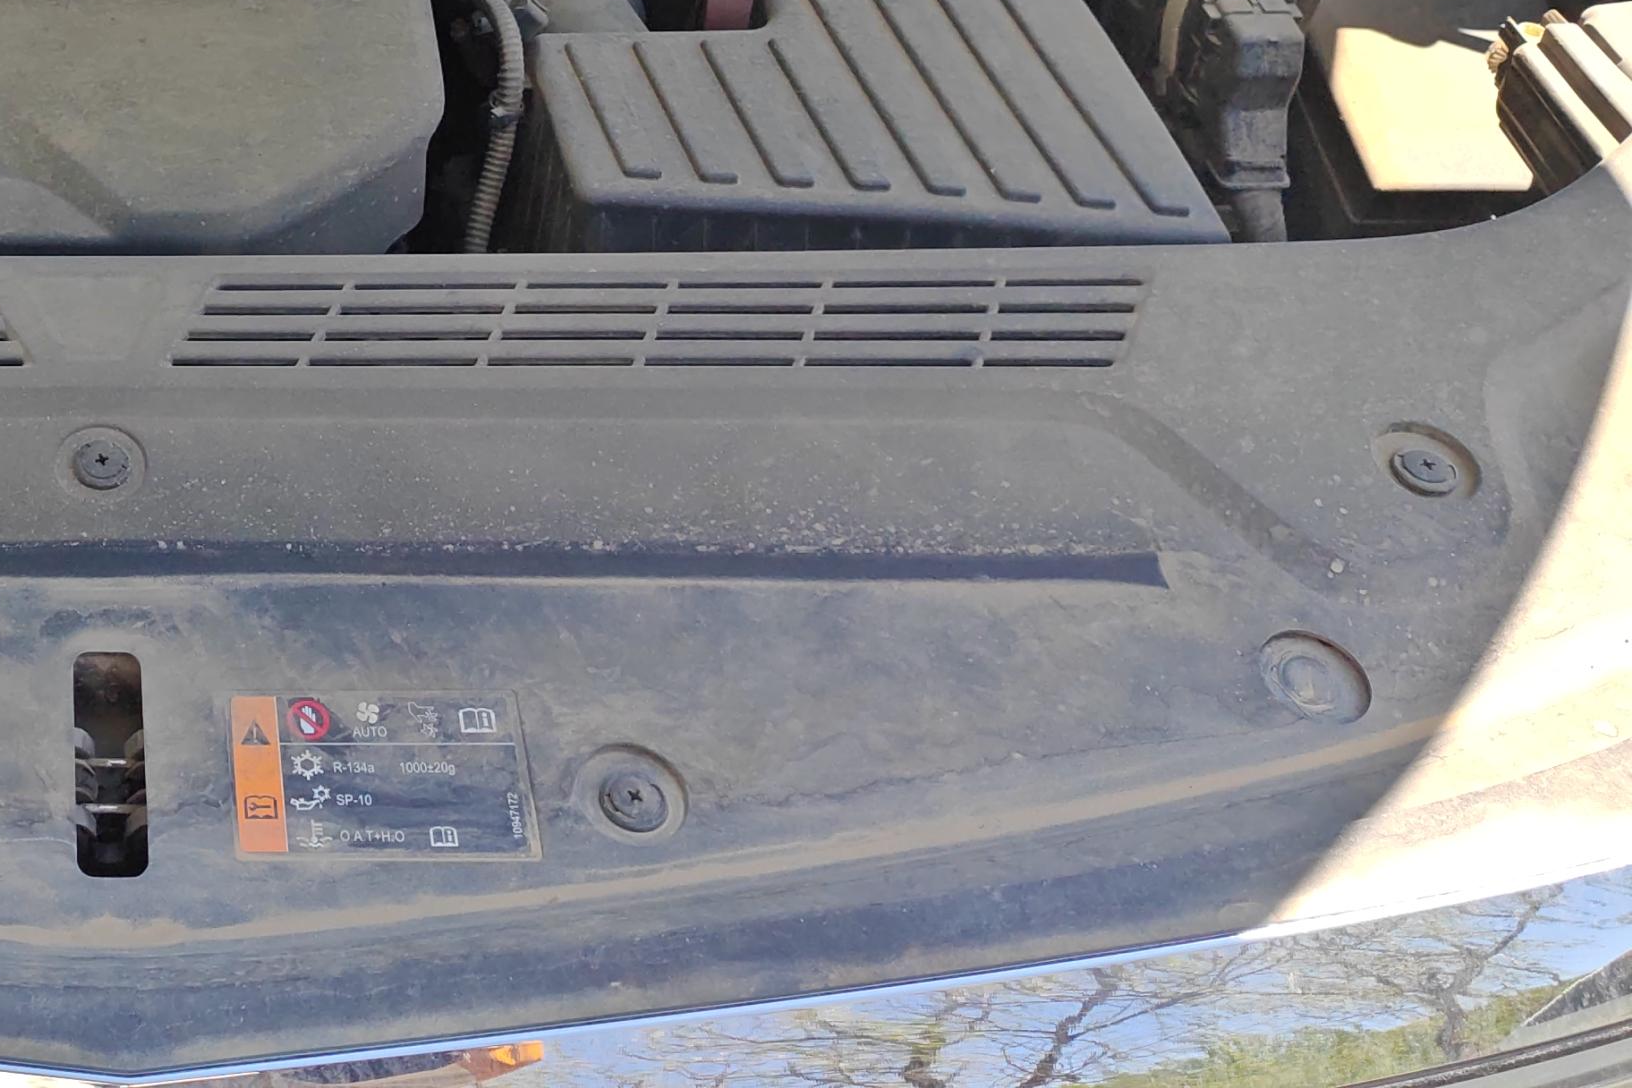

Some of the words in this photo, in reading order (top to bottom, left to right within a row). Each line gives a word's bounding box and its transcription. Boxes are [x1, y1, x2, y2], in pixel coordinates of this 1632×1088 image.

[352, 725, 388, 738] AUTO
[333, 762, 375, 774] R-134a
[399, 761, 456, 775] 1000±20g
[335, 793, 373, 807] SP-10
[507, 791, 524, 839] 10947172
